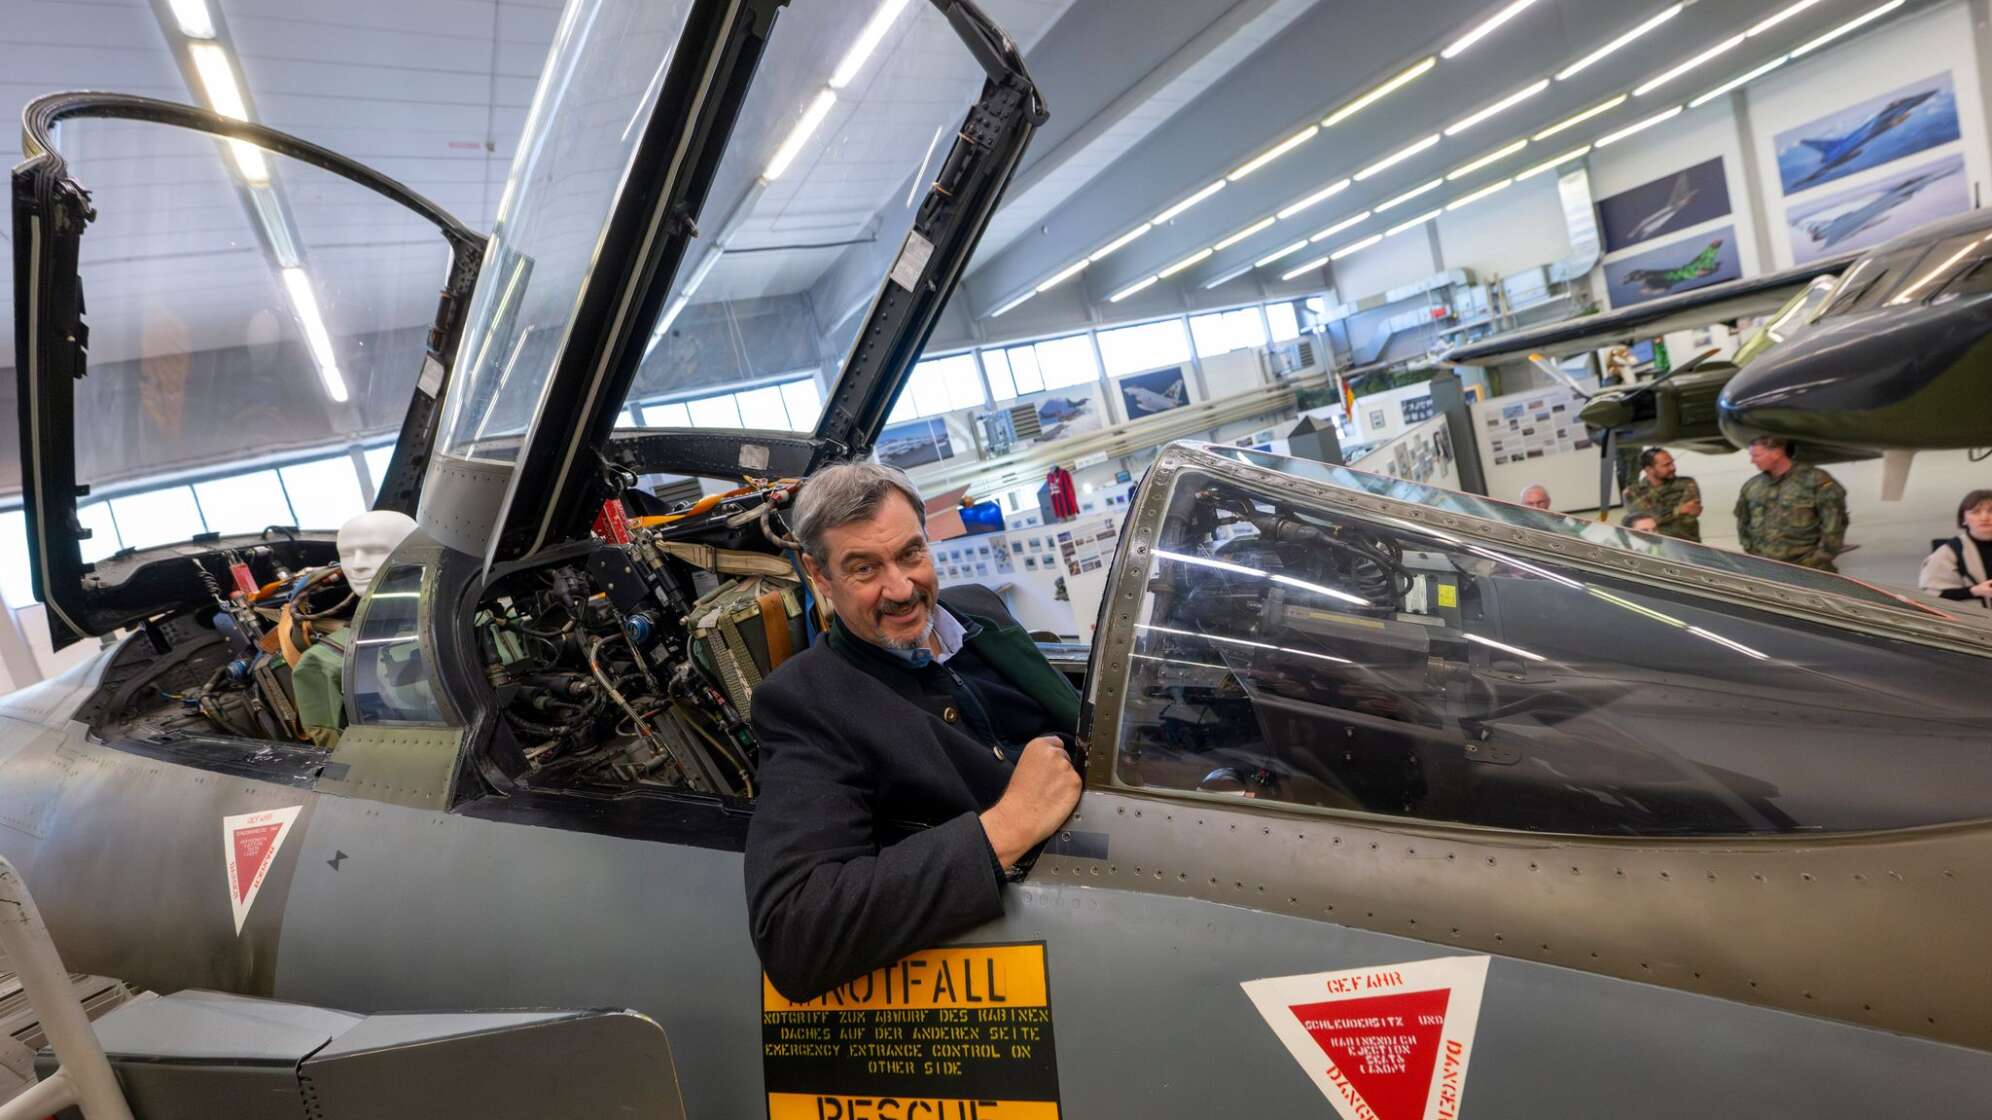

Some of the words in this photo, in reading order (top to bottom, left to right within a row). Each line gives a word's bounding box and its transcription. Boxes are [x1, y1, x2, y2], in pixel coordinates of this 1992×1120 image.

[1327, 971, 1403, 993] GEFAHR
[764, 1011, 830, 1025] NOTGRIFF
[839, 1011, 866, 1024] ZUM
[875, 1009, 929, 1023] ABWURF
[939, 1009, 969, 1022] DES
[978, 1008, 1049, 1023] KABINEN
[1304, 1016, 1404, 1030] SCHLEUDERSITZ
[1418, 1015, 1443, 1025] UND
[781, 1027, 831, 1040] DACHES
[840, 1027, 866, 1040] AUF
[875, 1026, 903, 1040] DER
[912, 1026, 980, 1040] ANDEREN
[989, 1026, 1040, 1041] SEITE
[764, 1043, 840, 1057] EMERGENCY
[849, 1043, 923, 1057] ENTRANCE
[932, 1044, 1000, 1058] CONTROL
[1011, 1044, 1032, 1058] ON
[1348, 1045, 1411, 1056] EJECTION
[868, 1060, 915, 1074] OTHER
[923, 1060, 963, 1075] SIDE
[1326, 1066, 1380, 1120] DANG
[817, 1096, 998, 1120] RESCUE
